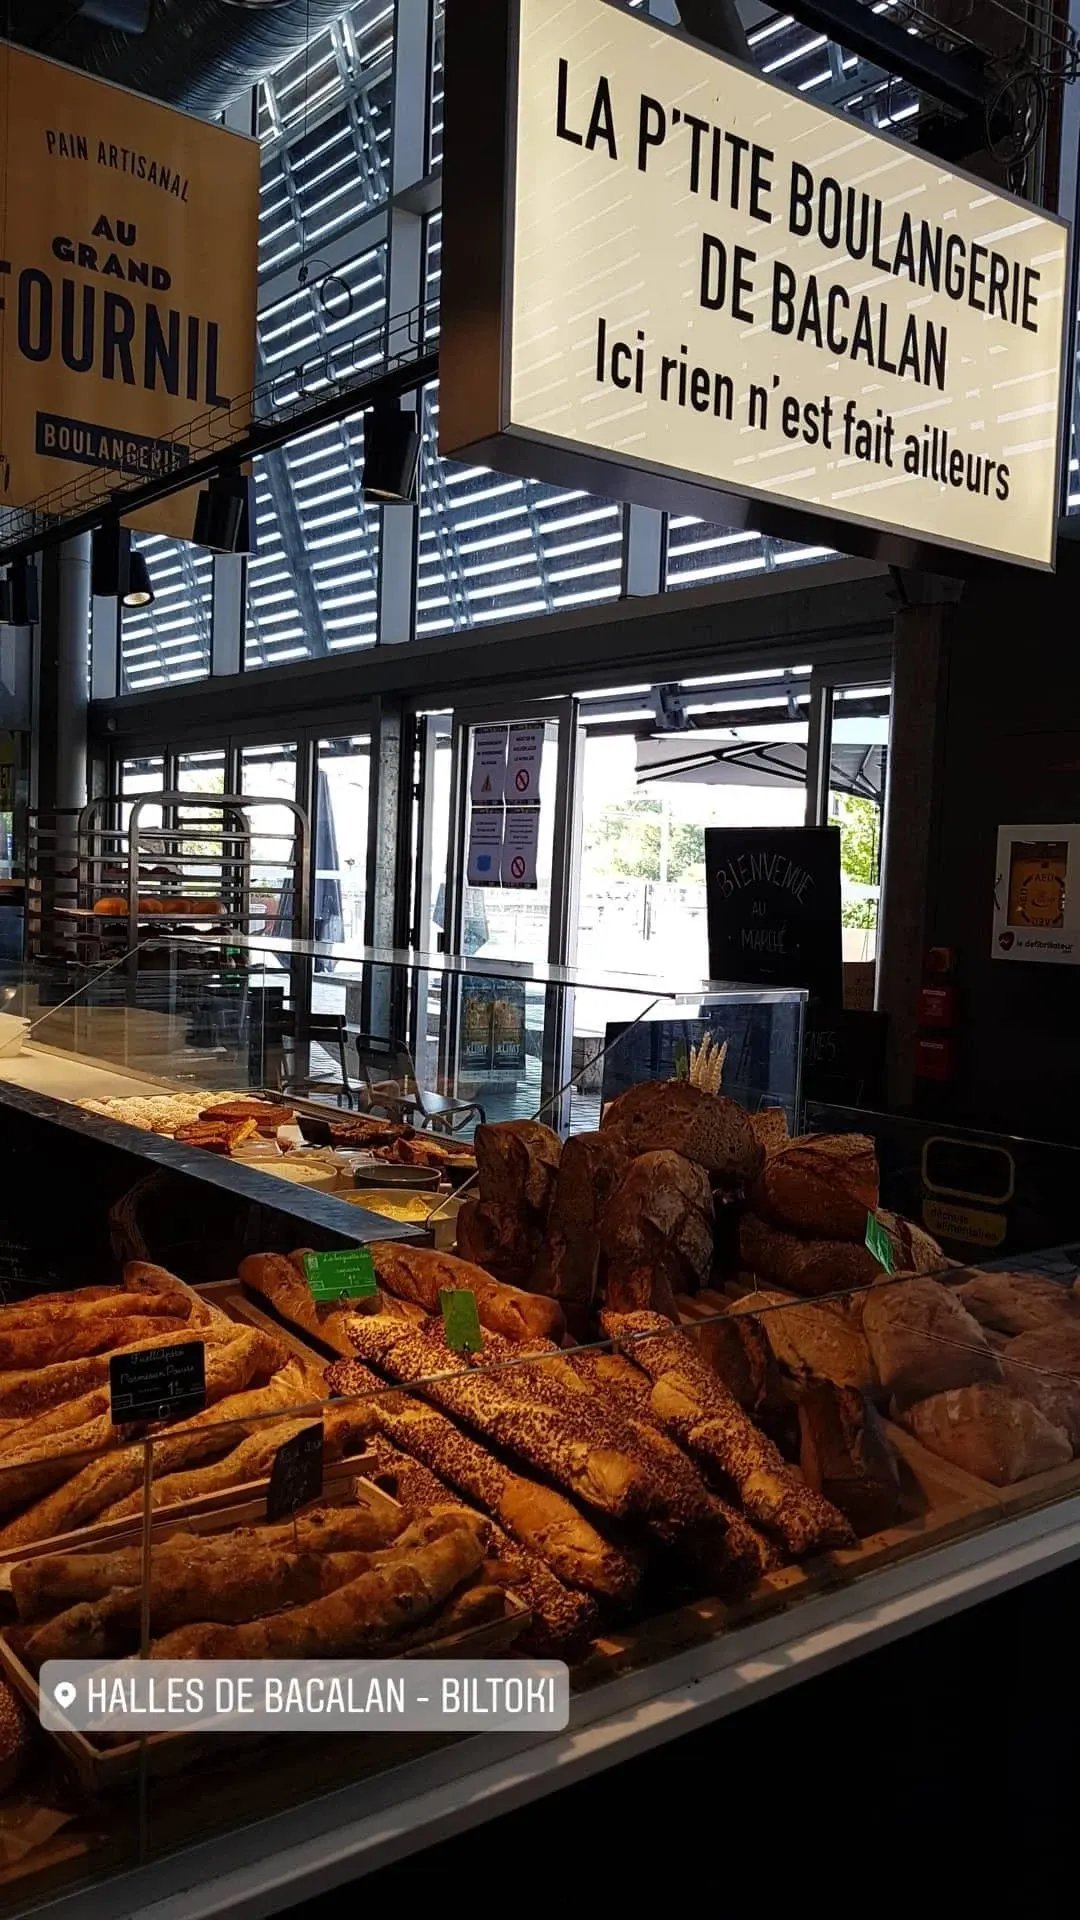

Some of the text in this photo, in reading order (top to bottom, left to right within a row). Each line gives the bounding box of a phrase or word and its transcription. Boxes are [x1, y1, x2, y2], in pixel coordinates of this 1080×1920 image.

[44, 129, 190, 203] PAIN ARTISANAL
[556, 57, 1041, 333] LA P'TITE BOULANGERIE
[91, 213, 137, 247] AU
[51, 235, 172, 292] GRAND
[700, 232, 948, 391] DE BACALAN
[596, 317, 1010, 501] Ici rien n'est fait ailleurs
[44, 422, 182, 473] BOULANGERIE
[715, 852, 816, 904] BIENVENUE
[752, 901, 766, 915] AU
